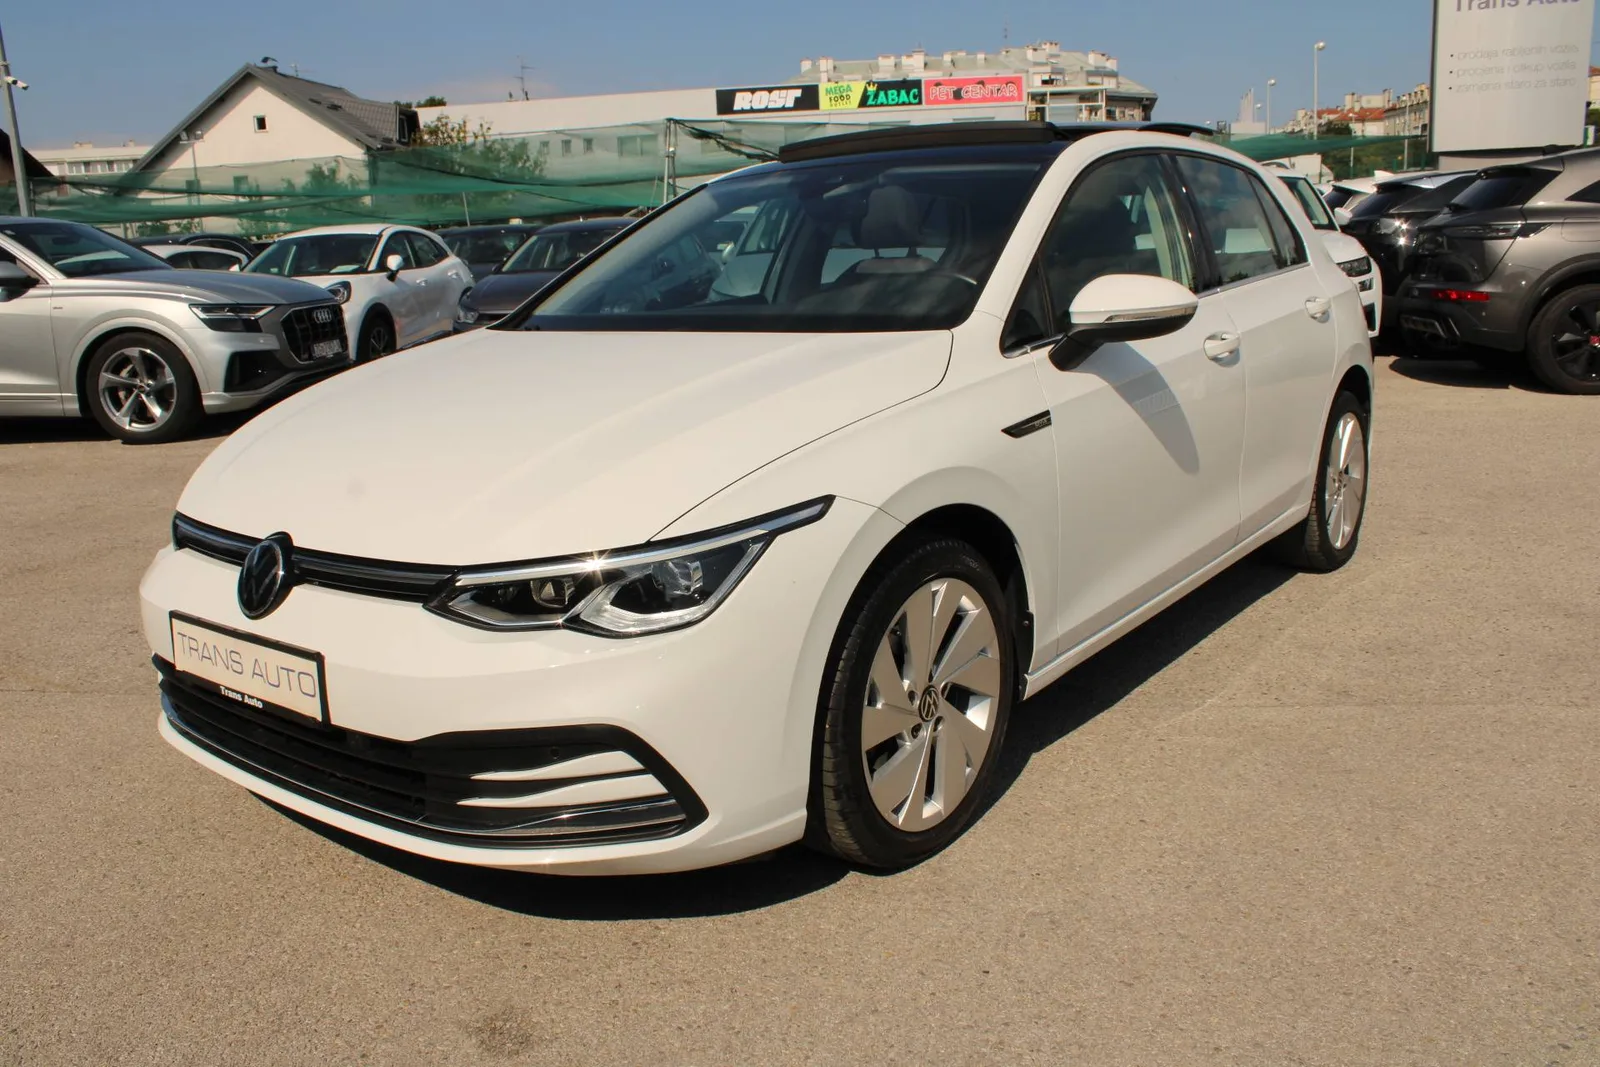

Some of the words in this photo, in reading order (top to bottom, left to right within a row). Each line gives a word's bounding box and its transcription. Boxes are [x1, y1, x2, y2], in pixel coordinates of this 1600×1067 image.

[733, 88, 802, 111] ROST
[825, 84, 853, 96] MEGA
[829, 94, 851, 103] FOOD
[929, 85, 955, 100] PET
[961, 83, 1018, 99] CENTAR
[177, 632, 244, 675] TRANS
[252, 658, 316, 698] AUTO
[219, 686, 242, 701] Trans
[244, 694, 264, 709] Auto
